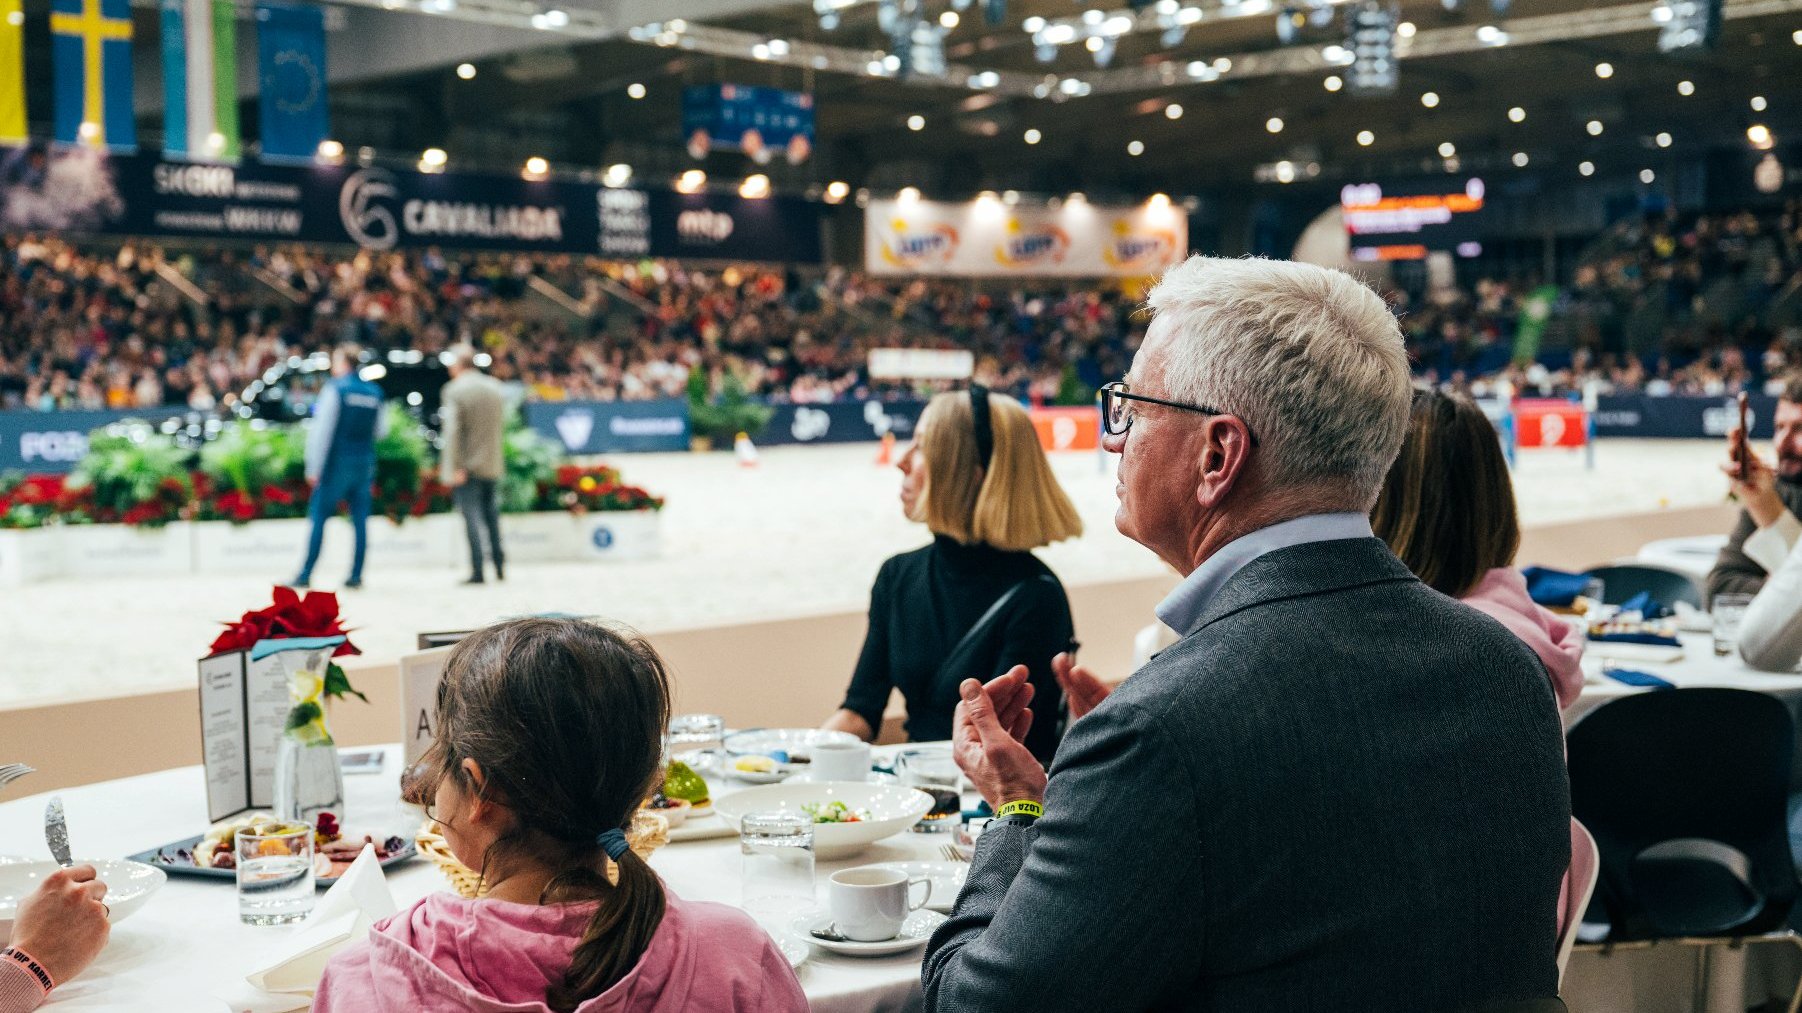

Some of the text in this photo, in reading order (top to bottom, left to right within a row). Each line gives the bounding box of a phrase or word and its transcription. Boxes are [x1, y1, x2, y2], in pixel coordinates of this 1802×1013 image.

[403, 199, 562, 240] CAVALIADA
[677, 209, 733, 241] mtp
[13, 951, 52, 991] VIP KARNET
